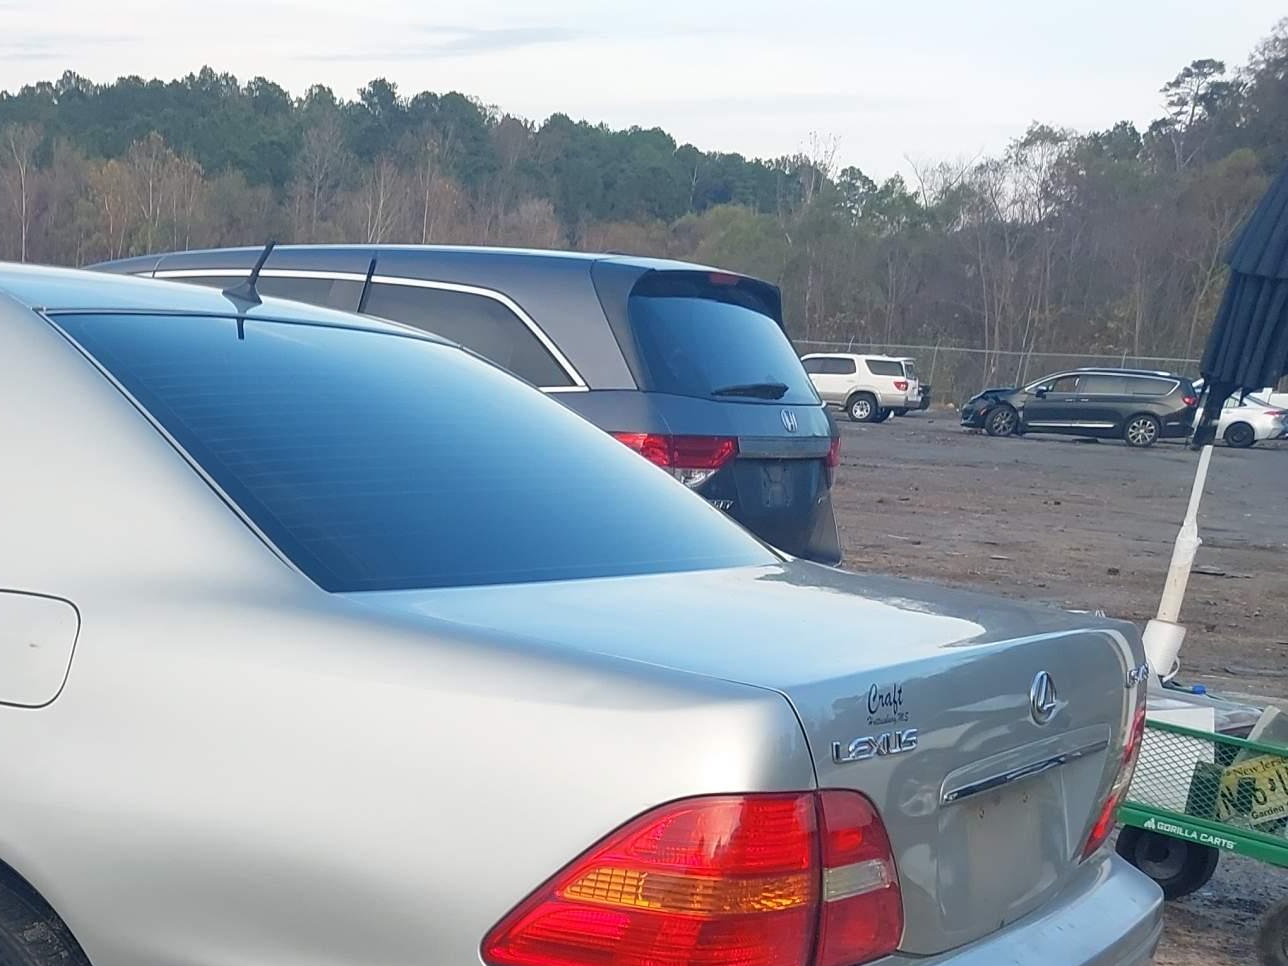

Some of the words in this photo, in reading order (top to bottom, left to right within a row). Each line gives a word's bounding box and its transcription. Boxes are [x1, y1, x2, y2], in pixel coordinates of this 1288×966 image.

[868, 683, 903, 714] Craft
[832, 728, 918, 764] LEXUS
[1251, 804, 1285, 820] Garden
[1157, 821, 1198, 840] GORILLA
[1199, 833, 1234, 850] CARTS
